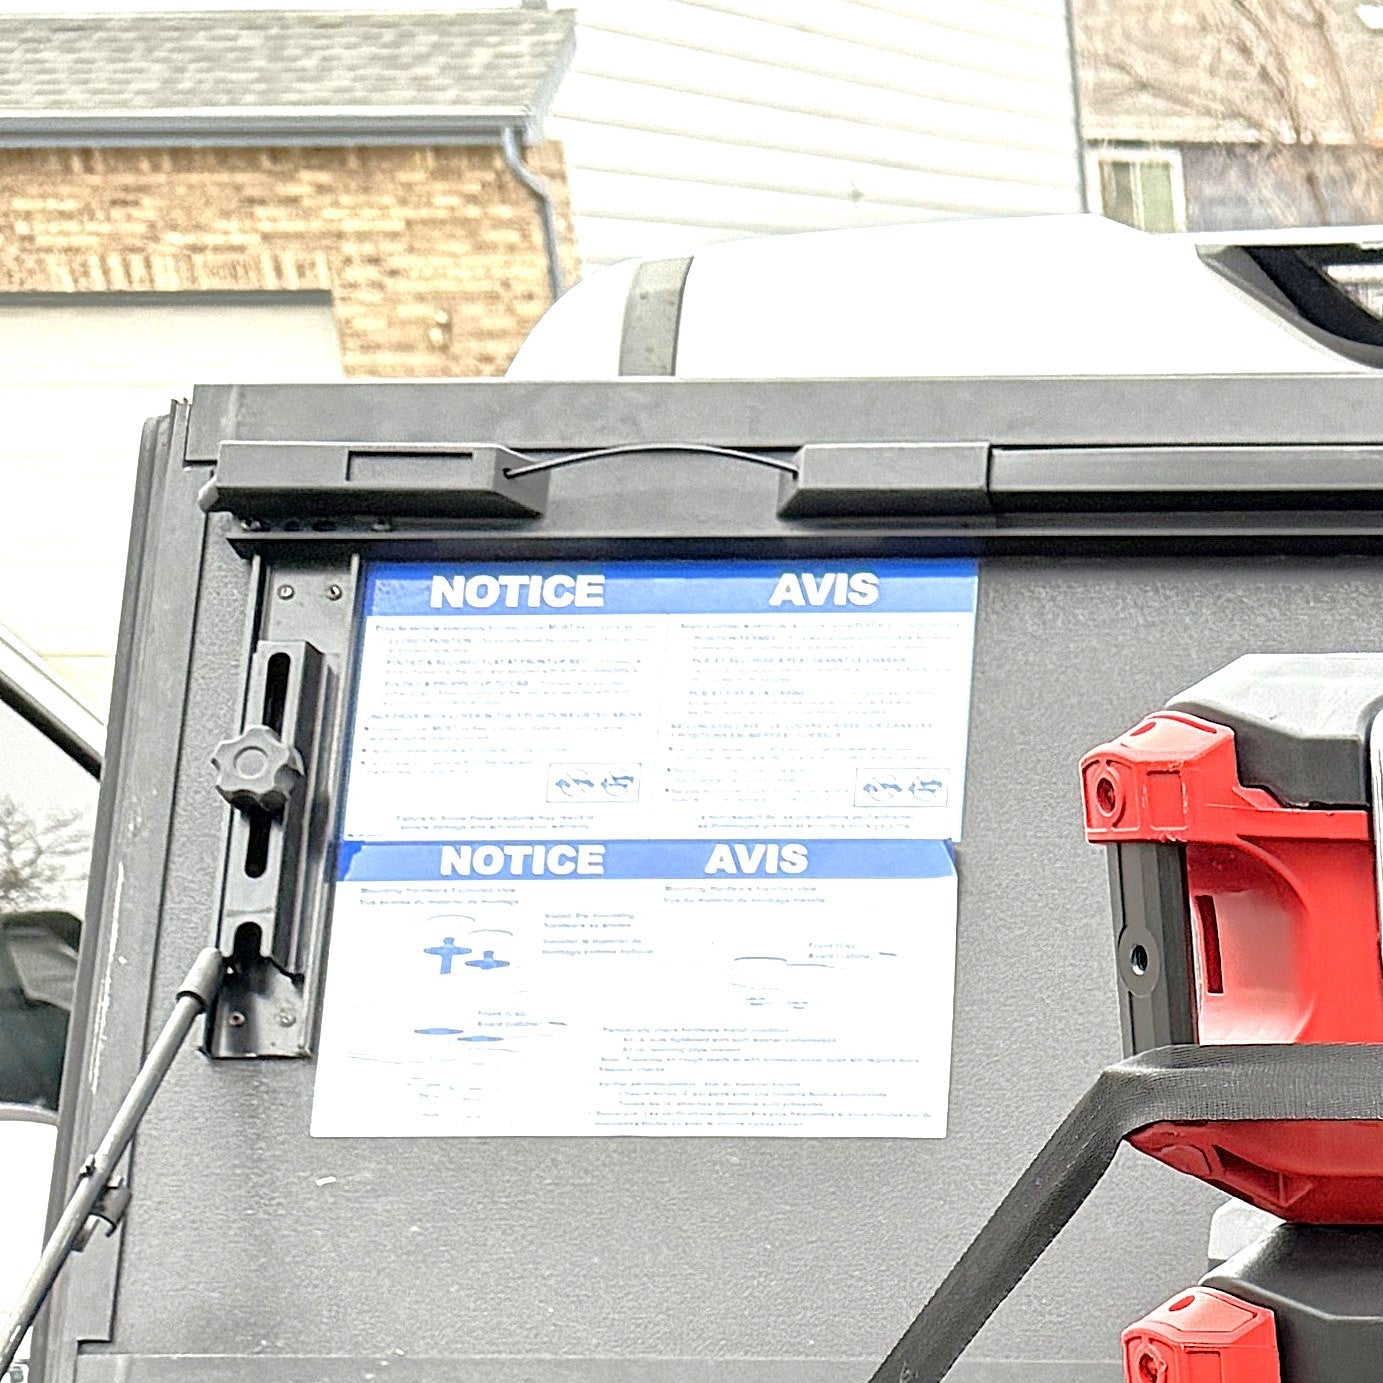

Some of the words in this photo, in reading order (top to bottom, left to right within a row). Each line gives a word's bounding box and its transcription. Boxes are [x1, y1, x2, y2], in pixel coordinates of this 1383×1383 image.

[429, 573, 606, 609] NOTICE
[768, 571, 880, 607] AVIS
[440, 843, 606, 877] NOTICE
[703, 842, 810, 875] AVIS
